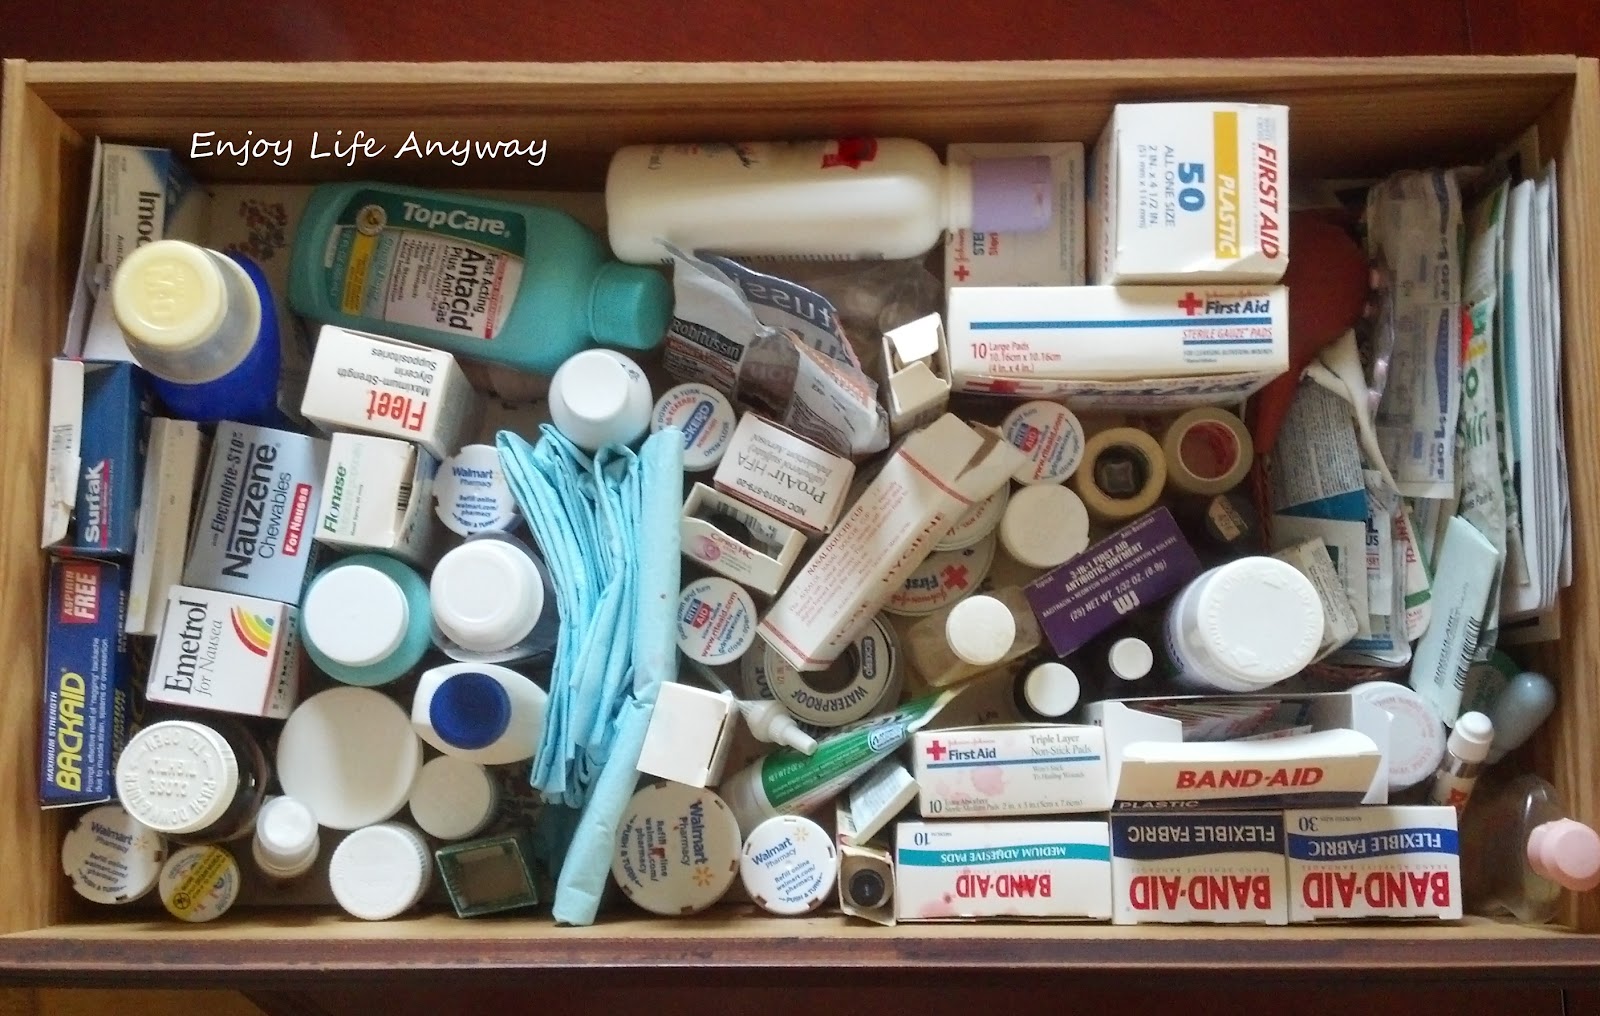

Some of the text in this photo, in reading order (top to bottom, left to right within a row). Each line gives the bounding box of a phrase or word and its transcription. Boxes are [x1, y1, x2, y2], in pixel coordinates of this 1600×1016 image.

[1164, 145, 1175, 227] ALL ONE SIZE
[1178, 162, 1205, 212] 50
[1258, 143, 1278, 213] FIRST
[403, 202, 506, 235] TopCare
[1218, 174, 1236, 255] PLASTIC
[1260, 212, 1280, 259] AID
[483, 252, 498, 276] Fast
[434, 245, 463, 324] Plus Anti-Gas
[446, 247, 488, 331] Antacid
[472, 277, 493, 314] Acting
[1205, 300, 1270, 314] First Aid
[669, 317, 742, 360] Robitussin
[971, 343, 987, 359] 10
[989, 342, 1029, 351] Large Pads
[371, 347, 438, 371] Suppositories
[990, 352, 1061, 362] 10.16cm 10.16cm
[337, 367, 431, 397] Maximum-Strength
[393, 367, 434, 384] Glycerin
[367, 389, 427, 432] Fleet
[676, 403, 714, 444] CKERD
[452, 466, 493, 479] Walmart
[733, 451, 767, 475] HFA
[460, 479, 492, 488] Pharmacy
[85, 461, 105, 543] Surfak
[222, 444, 278, 579] Nauzene
[323, 465, 347, 533] Flonase
[787, 501, 807, 515] NDC
[259, 472, 292, 559] Chewables
[285, 487, 309, 553] For Nausea
[806, 504, 865, 575] NASAL DOUCHE CUP
[1064, 541, 1144, 592] ANTIBIOTIC OINTMENT
[1069, 539, 1129, 579] 3-IN-1 FIRST AID
[63, 570, 74, 615] ASPIRIN
[74, 572, 98, 620] FREE
[905, 575, 939, 591] First
[1084, 597, 1101, 612] NET
[1114, 579, 1132, 594] 1/32
[685, 601, 699, 621] RITE
[696, 607, 709, 624] AID
[701, 592, 737, 657] www.riteaid.com
[90, 637, 100, 671] backache
[164, 600, 208, 694] Emetrol
[194, 620, 223, 697] for Nausea
[791, 686, 869, 713] WATERPROOF
[46, 690, 58, 781] MAXIMUM STRENGTH
[55, 671, 86, 792] BACKAID
[88, 715, 96, 732] relief
[87, 733, 97, 763] effective
[949, 747, 996, 760] First Aid
[1029, 734, 1080, 745] Triple Layer
[1031, 745, 1091, 756] Non-Stick Pads
[95, 742, 105, 768] muscle
[85, 764, 96, 792] Prompt,
[95, 778, 103, 792] due
[1176, 766, 1324, 790] BAND-AID
[929, 800, 942, 813] 10
[1119, 800, 1199, 810] PLASTIC
[90, 821, 133, 845] Walmart
[656, 820, 668, 845] Refill
[689, 799, 708, 865] Walmart
[1127, 824, 1276, 843] FLEXIBLE FABRIC
[1298, 816, 1318, 831] 30
[620, 824, 638, 883] PUSH TURN
[636, 828, 647, 874] pharmacy
[679, 816, 691, 866] Pharmacy
[752, 837, 793, 866] Walmart
[914, 832, 931, 846] 10
[1307, 832, 1441, 855] FLEXIBLE FABRIC
[765, 848, 797, 869] Pharmacy
[940, 846, 1066, 864] MEDIUM ADHESIVE PADS
[774, 859, 810, 884] Refill online
[776, 864, 816, 891] walmart.com/
[785, 875, 815, 895] pharmacy
[956, 875, 1052, 898] BAND-AID
[1129, 875, 1272, 911] BAND-AID
[1302, 871, 1449, 909] BAND-AID
